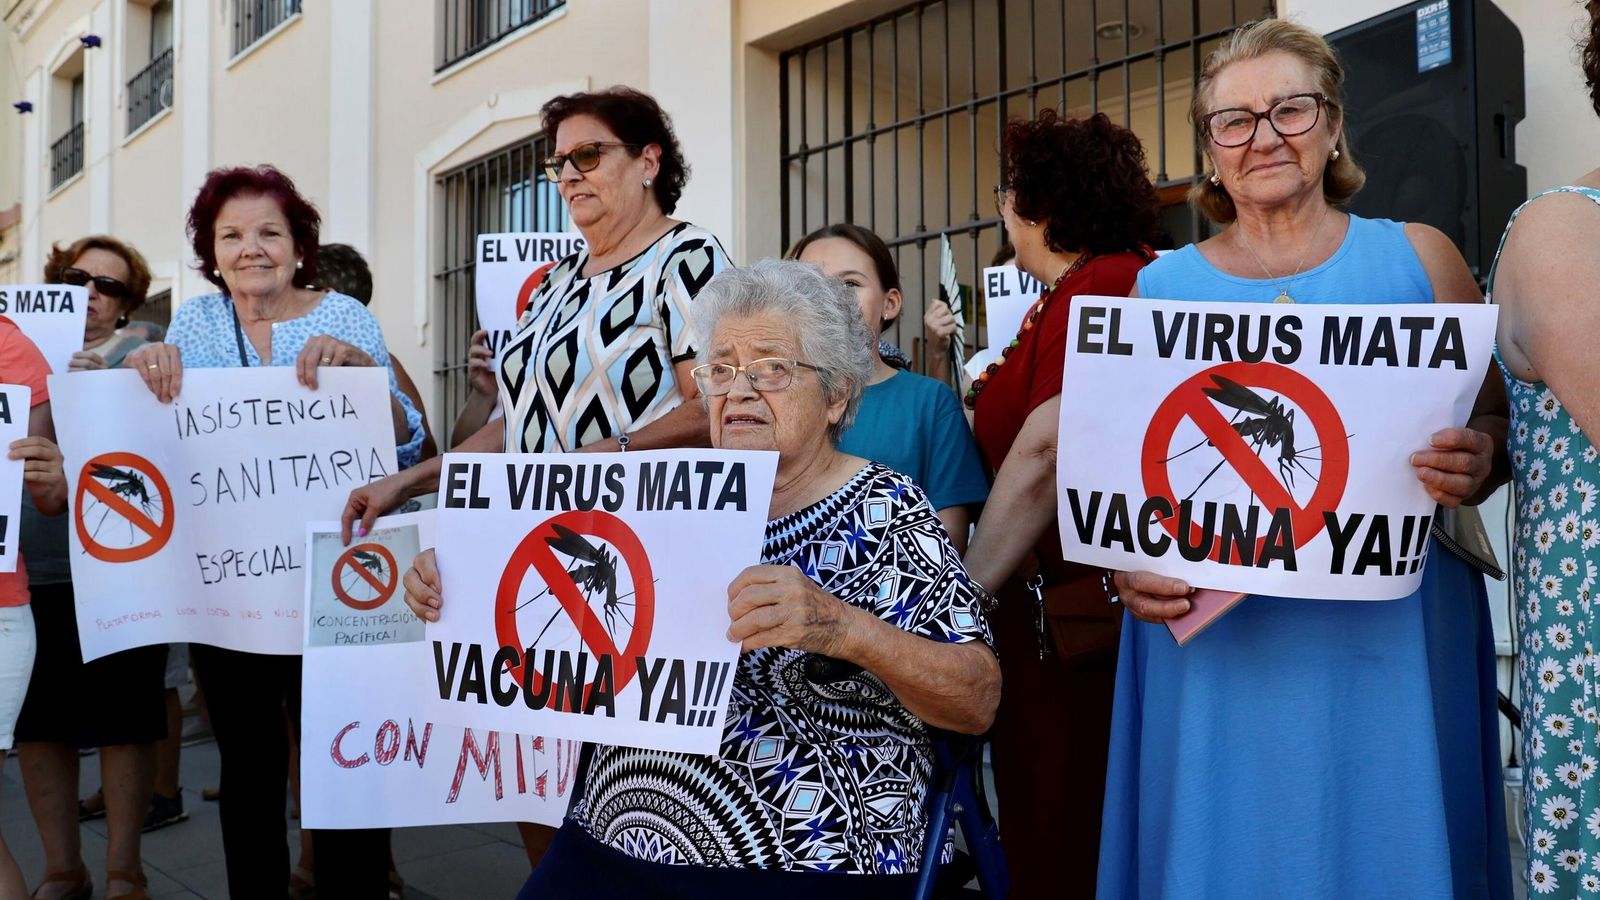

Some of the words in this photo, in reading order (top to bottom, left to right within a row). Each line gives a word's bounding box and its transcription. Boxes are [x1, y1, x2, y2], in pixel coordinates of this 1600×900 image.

[482, 240, 508, 262] EL
[515, 239, 585, 262] VIRUS
[16, 291, 75, 313] MATA
[988, 271, 1011, 298] EL
[1018, 270, 1046, 297] VI
[1077, 306, 1134, 356] EL
[1152, 310, 1304, 365] VIRUS
[1320, 316, 1469, 370] MATA
[190, 447, 389, 506] SANITARIA
[445, 463, 491, 509] EL
[506, 463, 626, 512] VIRUS
[636, 461, 748, 512] MATA
[1067, 488, 1298, 572] VACUNA
[196, 545, 301, 585] ESPECIAL
[96, 610, 162, 632] PLATAFORMA
[432, 641, 617, 718] VACUNA
[635, 656, 730, 728] YA!!!
[331, 718, 433, 769] CON
